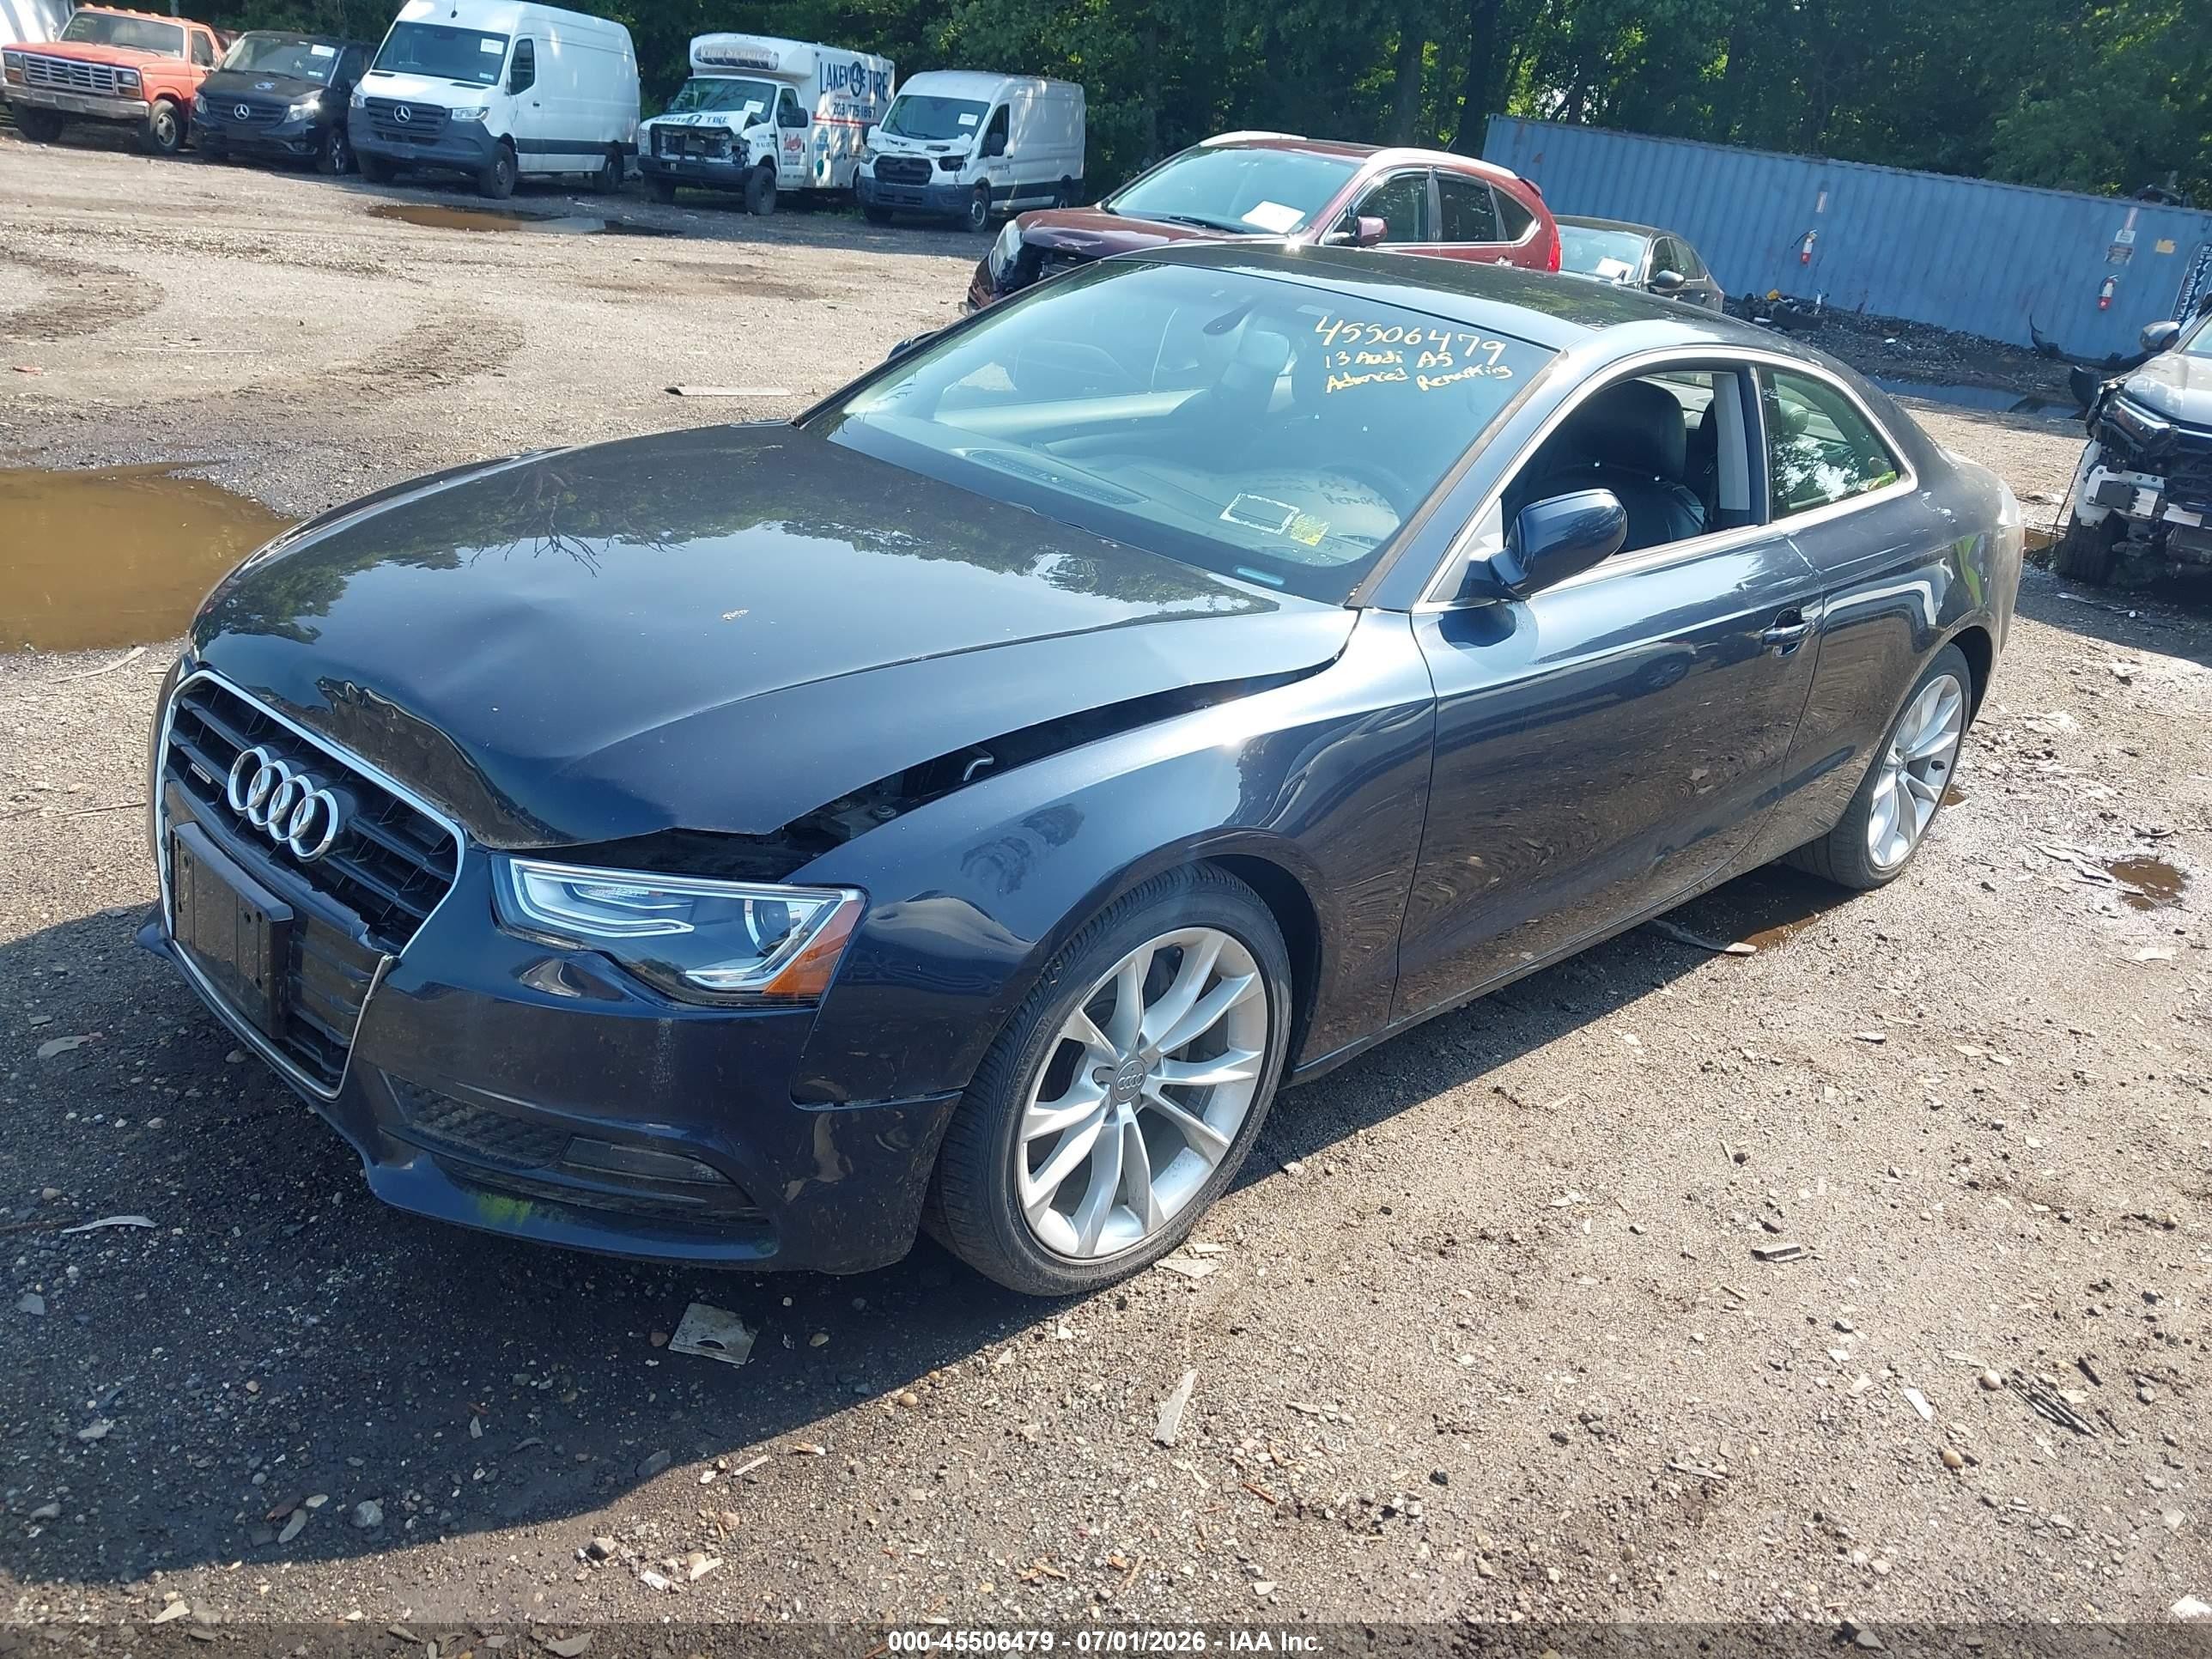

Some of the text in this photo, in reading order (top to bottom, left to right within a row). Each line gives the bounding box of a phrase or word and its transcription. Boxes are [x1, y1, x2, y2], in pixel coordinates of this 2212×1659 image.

[869, 70, 888, 102] TIRE
[834, 102, 845, 116] 203
[1315, 316, 1507, 366] 45506479
[1326, 350, 1352, 369] 13
